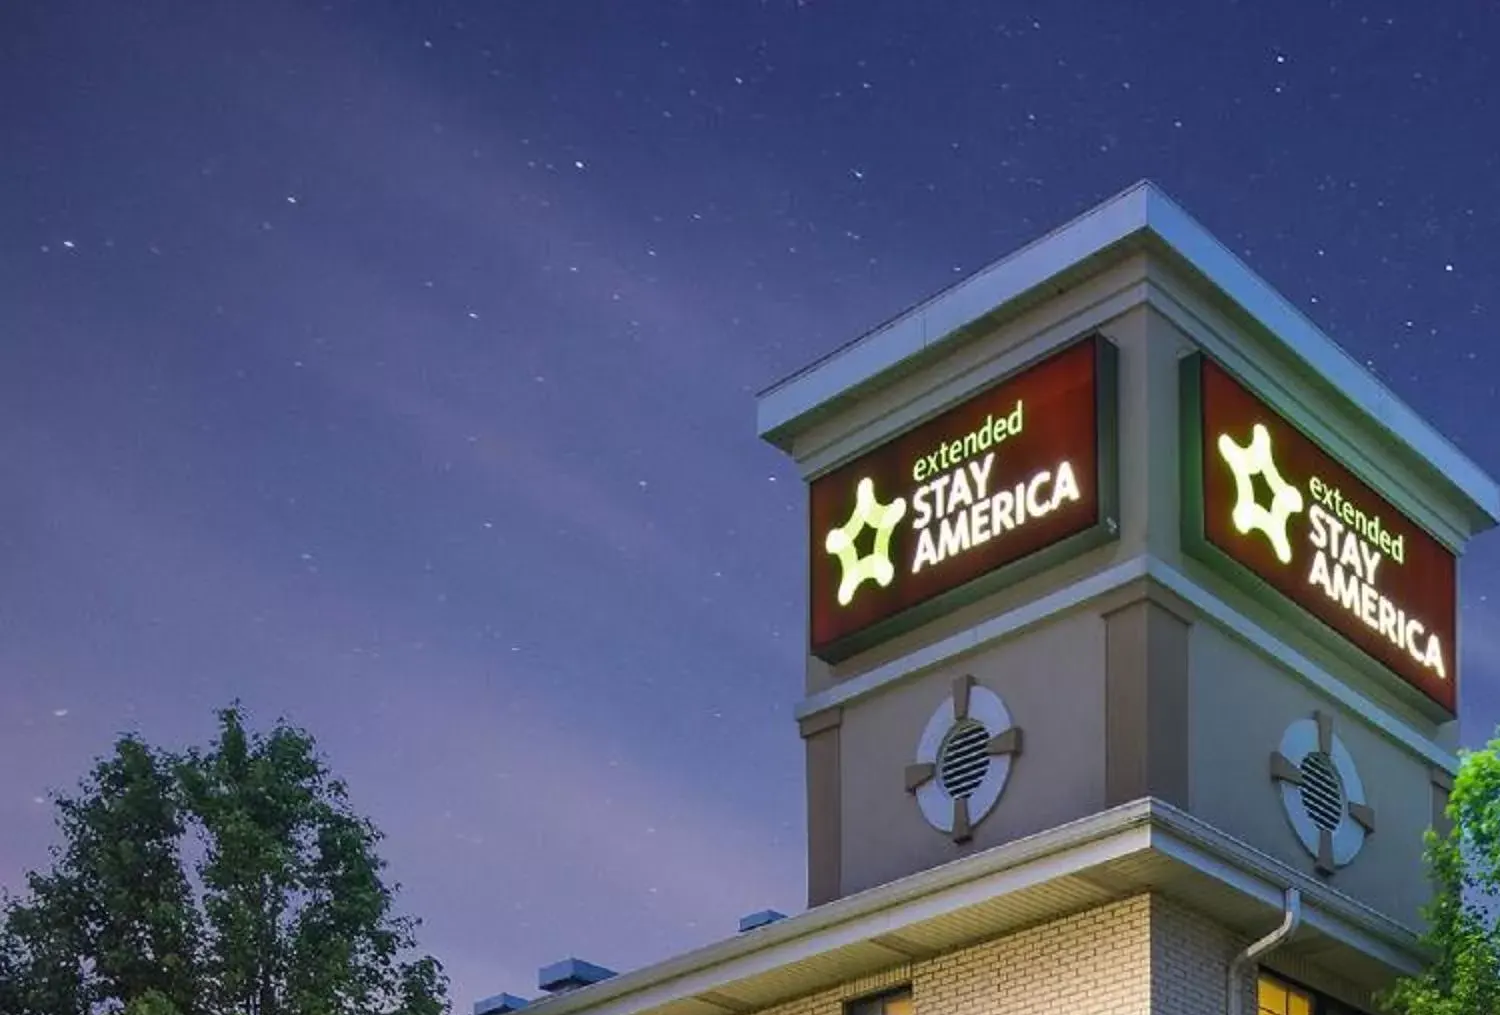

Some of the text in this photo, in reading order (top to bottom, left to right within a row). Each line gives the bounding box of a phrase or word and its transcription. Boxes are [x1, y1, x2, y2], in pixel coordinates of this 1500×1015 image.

[914, 400, 1024, 481] extended
[912, 461, 1080, 573] AMERICA
[913, 453, 995, 529] STAY
[1309, 476, 1404, 564] extended
[1308, 505, 1381, 584] STAY
[1308, 552, 1445, 678] AMERICA
